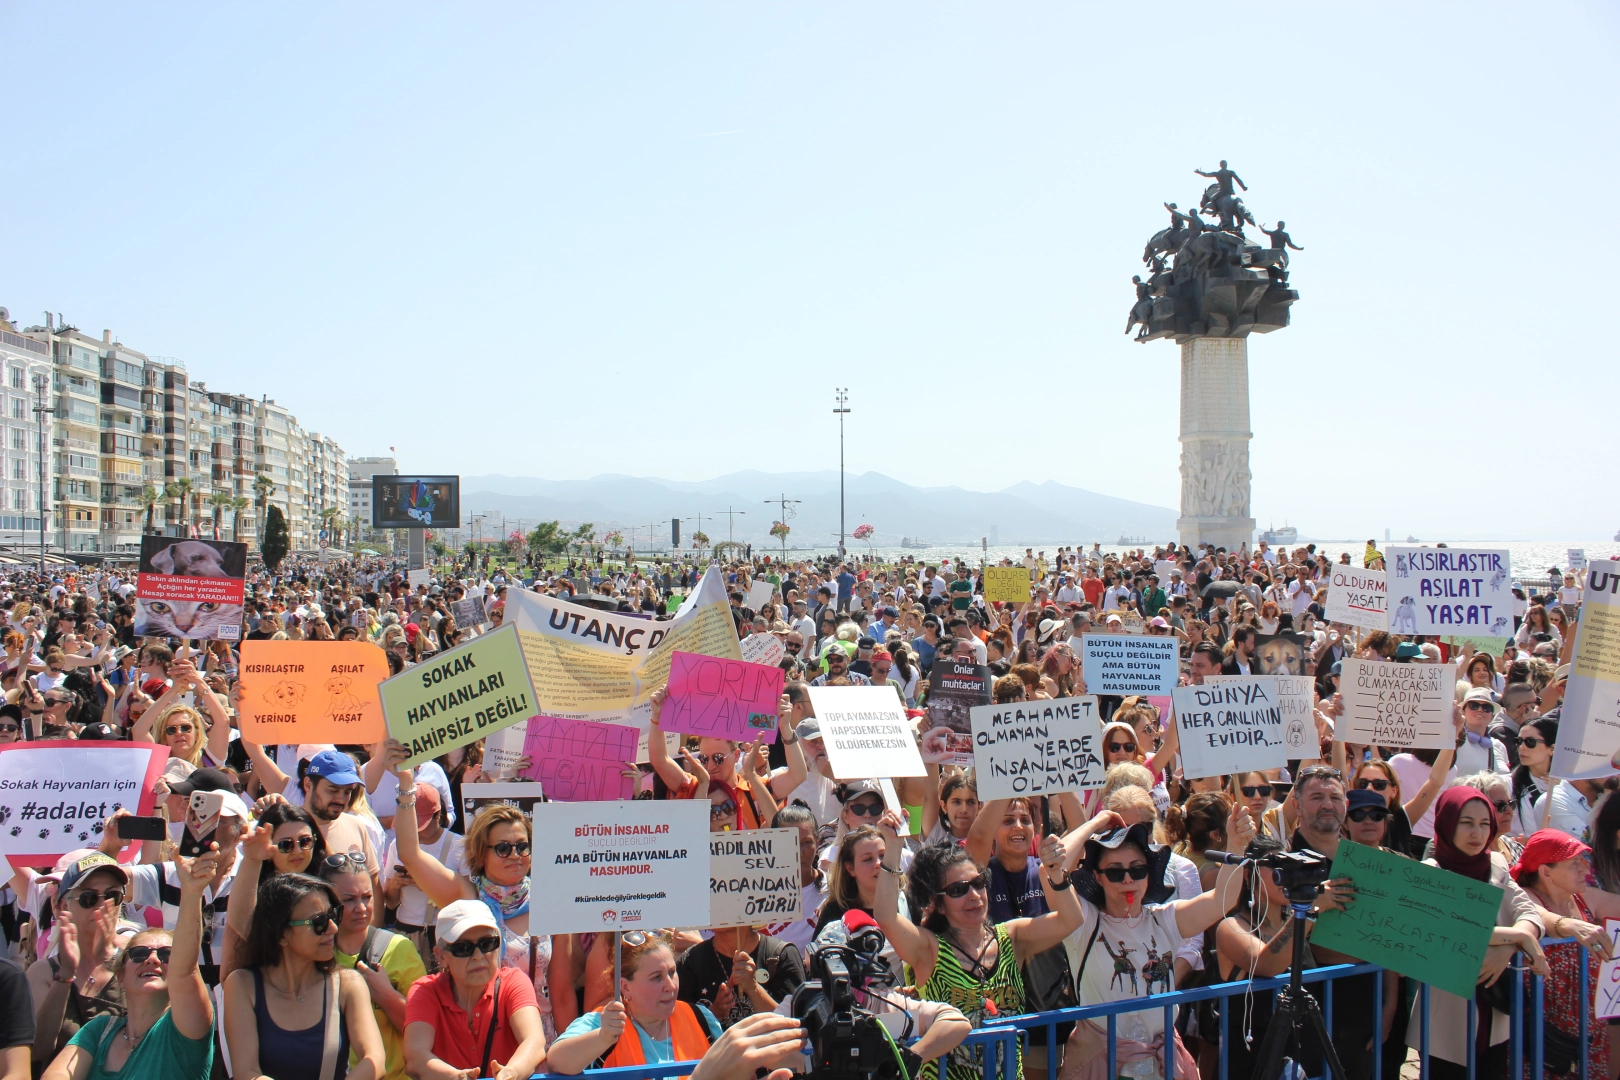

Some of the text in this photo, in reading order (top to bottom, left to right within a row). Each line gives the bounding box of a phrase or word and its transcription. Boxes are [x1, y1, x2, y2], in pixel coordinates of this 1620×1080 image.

[1408, 552, 1503, 573] KISIRLAŞTIR
[1334, 571, 1387, 592] ÖLDÜRM
[1420, 578, 1483, 598] AŞILAT
[196, 594, 239, 602] YARADAN!!!
[1426, 604, 1492, 627] YAŞAT
[549, 608, 645, 656] UTANÇ
[1087, 639, 1173, 650] BÜTÜN İNSANLAR
[1090, 651, 1171, 660] SUÇLU DEĞİLDİR
[245, 664, 364, 675] KISIRLAŞTIR AŞILAT
[422, 652, 476, 688] SOKAK
[954, 664, 974, 674] Onlar
[1127, 662, 1160, 670] BÜTÜN
[1359, 664, 1374, 676] BU
[1379, 666, 1416, 679] ÜLKEDE
[1419, 669, 1424, 679] 4
[680, 655, 780, 705] YORUM
[1358, 676, 1442, 692] OLMAYACAKSIN!
[407, 671, 505, 725] HAYVANLARI
[1195, 684, 1270, 706] DÜNYA
[1378, 691, 1421, 703] KADIN
[668, 691, 749, 734] YAZAN
[993, 702, 1092, 727] MERHAMET
[1278, 700, 1297, 714] AHA
[1376, 702, 1419, 715] ÇOCUK
[254, 712, 363, 723] YERİNDE YAŞAT
[823, 712, 900, 722] TOPLAYAMAZSIN
[1182, 707, 1281, 729] HER CANLININ
[1376, 714, 1415, 727] AĞAÇ
[402, 693, 528, 759] SAHİPSİZ DEĞİL!
[830, 724, 902, 735] HAPSDEMEZSİN
[1374, 726, 1416, 739] HAYVAN
[977, 724, 1048, 746] OLMAYAN
[1206, 728, 1282, 747] EVİDİR...
[835, 738, 907, 749] ÖLDÜREMEZSİN
[1034, 735, 1092, 757] YERDE
[0, 780, 136, 792] Sokak Hayvanları için
[1012, 770, 1106, 792] OLMAZ...
[20, 802, 107, 820] #adalet
[575, 824, 670, 837] BÜTÜN İNSANLAR
[588, 836, 657, 848] SUÇLU DEĞİLDİR
[554, 849, 687, 864] AMA BÜTÜN HAYVANLAR
[590, 864, 653, 876] MASUMDUR.
[575, 891, 666, 903] #kürekledeğilyüreklegeldik
[745, 893, 797, 915] ÖTÜRÜ
